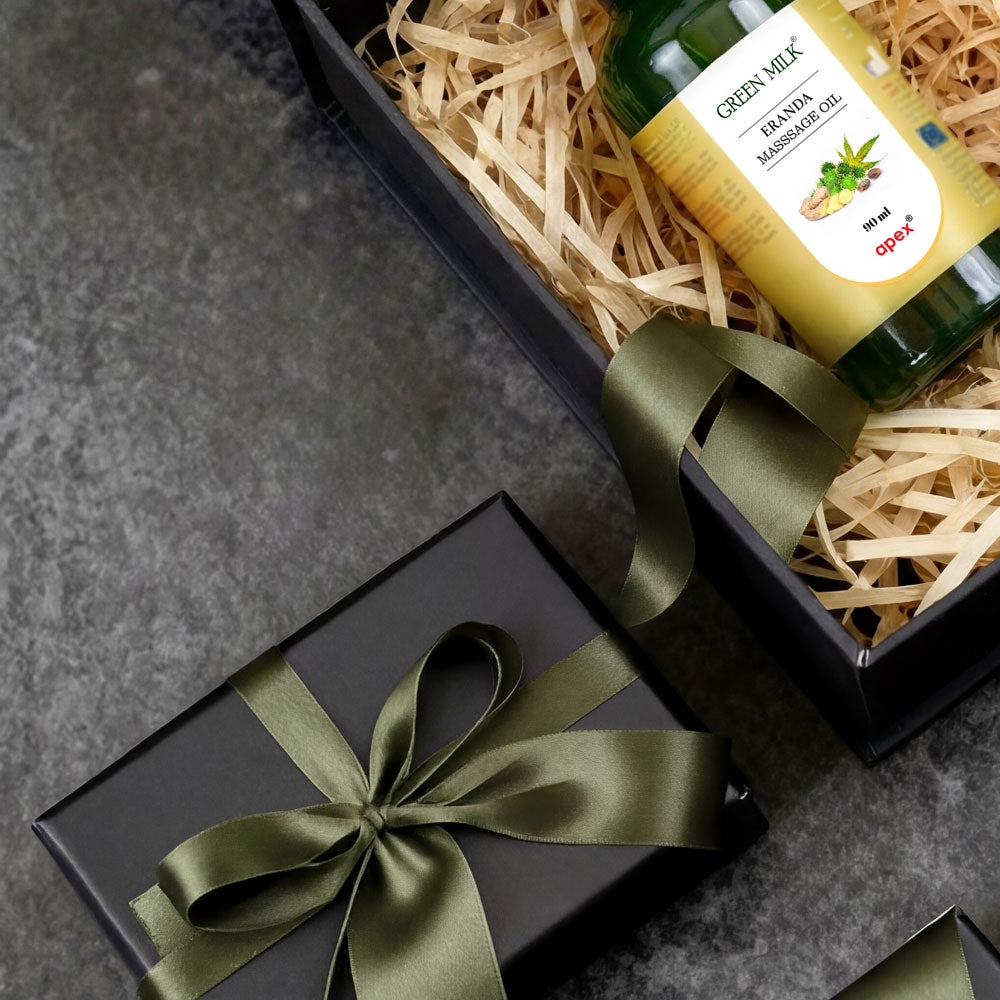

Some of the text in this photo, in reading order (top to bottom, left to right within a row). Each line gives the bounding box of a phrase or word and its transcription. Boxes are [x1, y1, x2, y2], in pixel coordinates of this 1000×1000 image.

[716, 73, 766, 119] GREEN
[760, 92, 814, 138] ERANDA
[756, 93, 843, 165] MASSSAGE OIL
[862, 206, 892, 232] 90 ml
